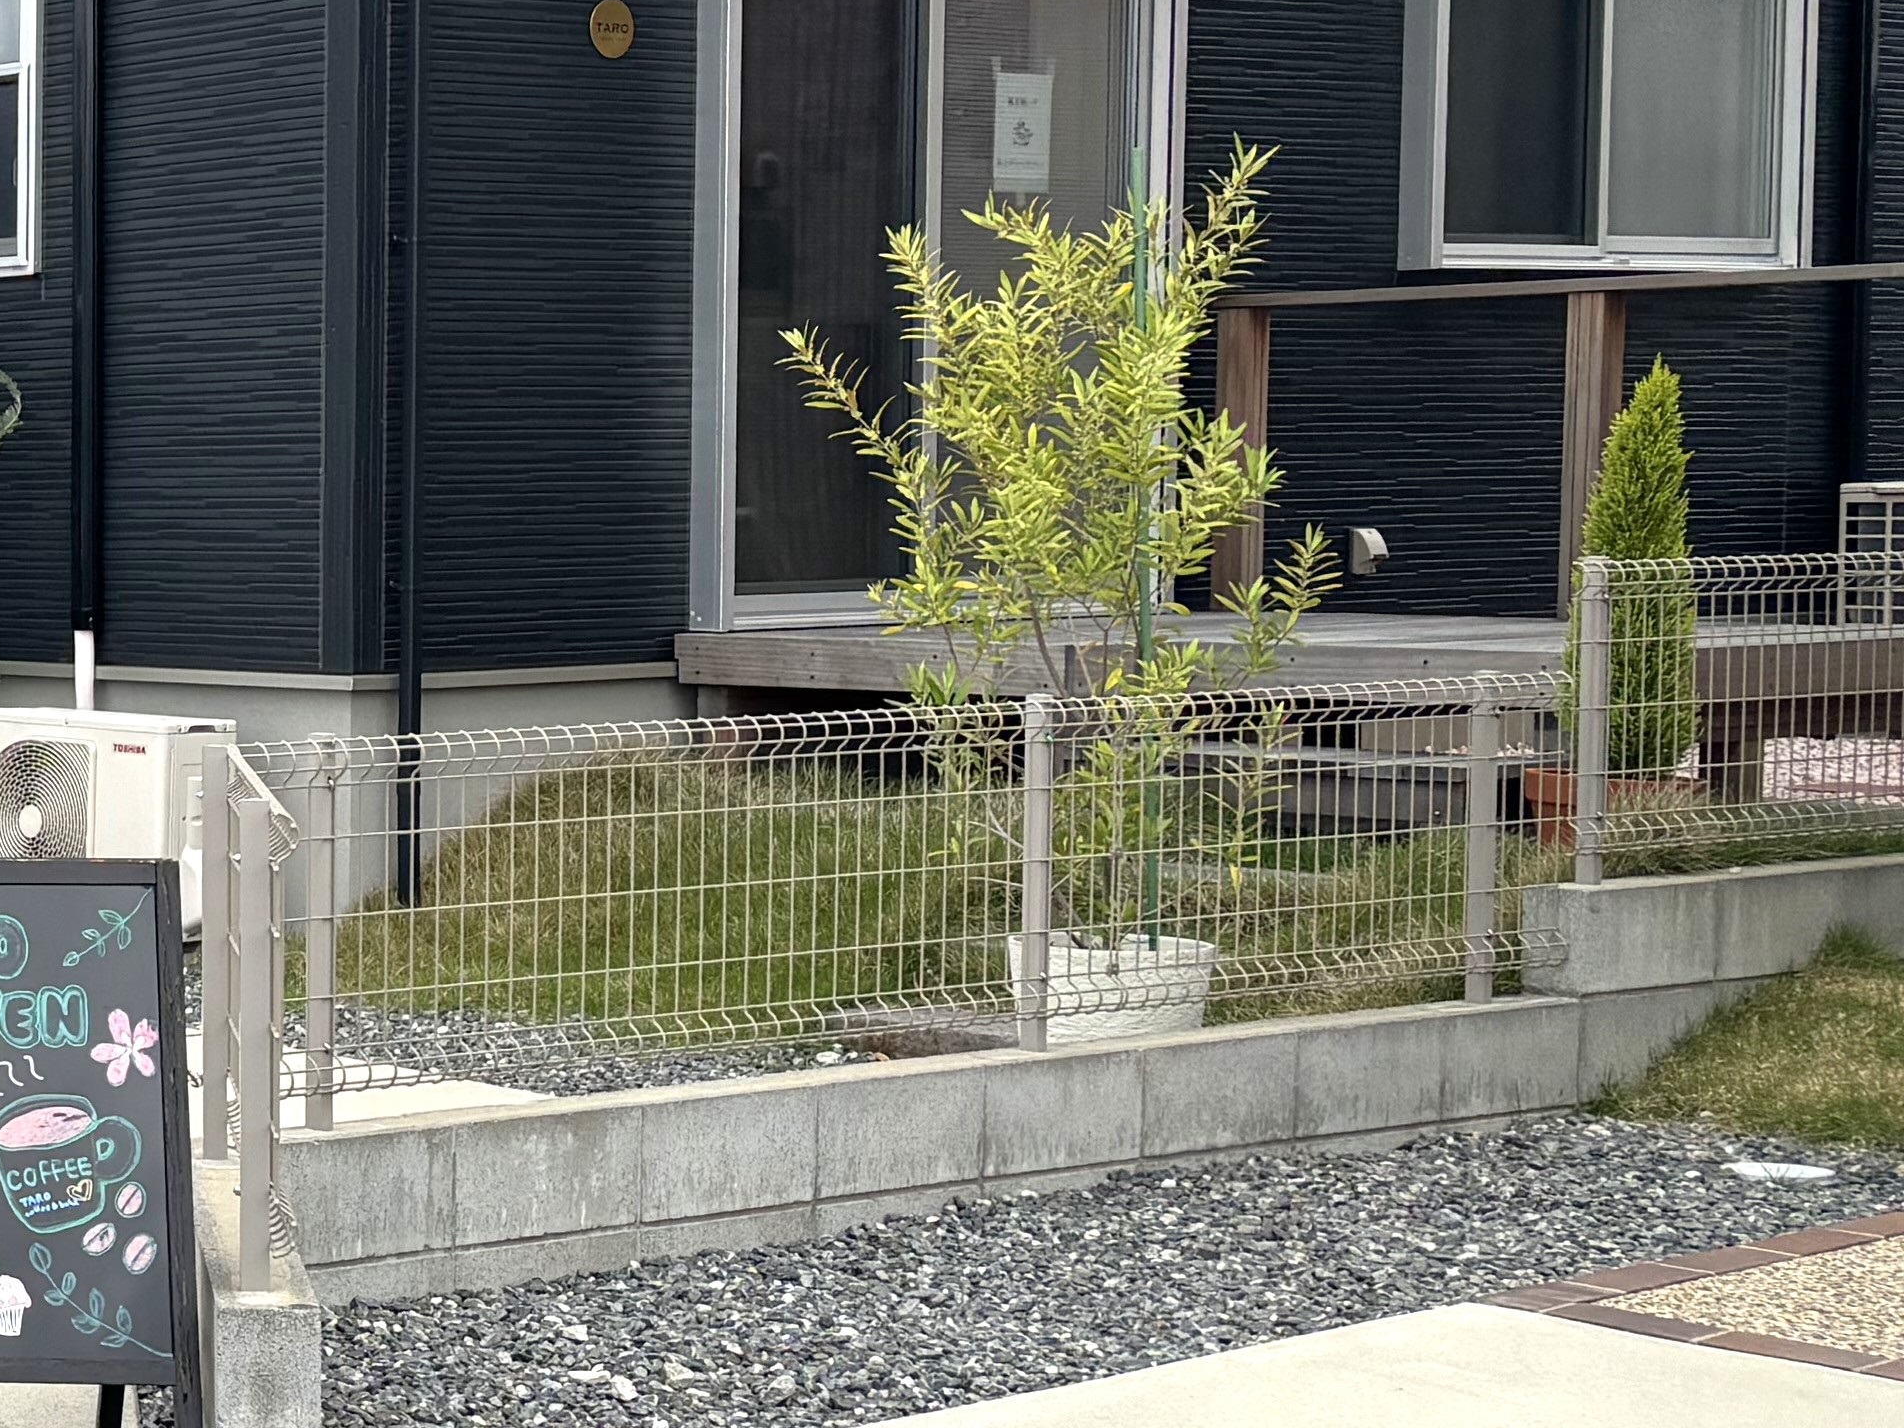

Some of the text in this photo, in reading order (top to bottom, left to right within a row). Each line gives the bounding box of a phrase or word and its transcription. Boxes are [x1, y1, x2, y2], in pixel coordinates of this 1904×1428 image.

[597, 22, 629, 34] TARO
[6, 1156, 93, 1191] COFFEE
[19, 1191, 52, 1208] TARO
